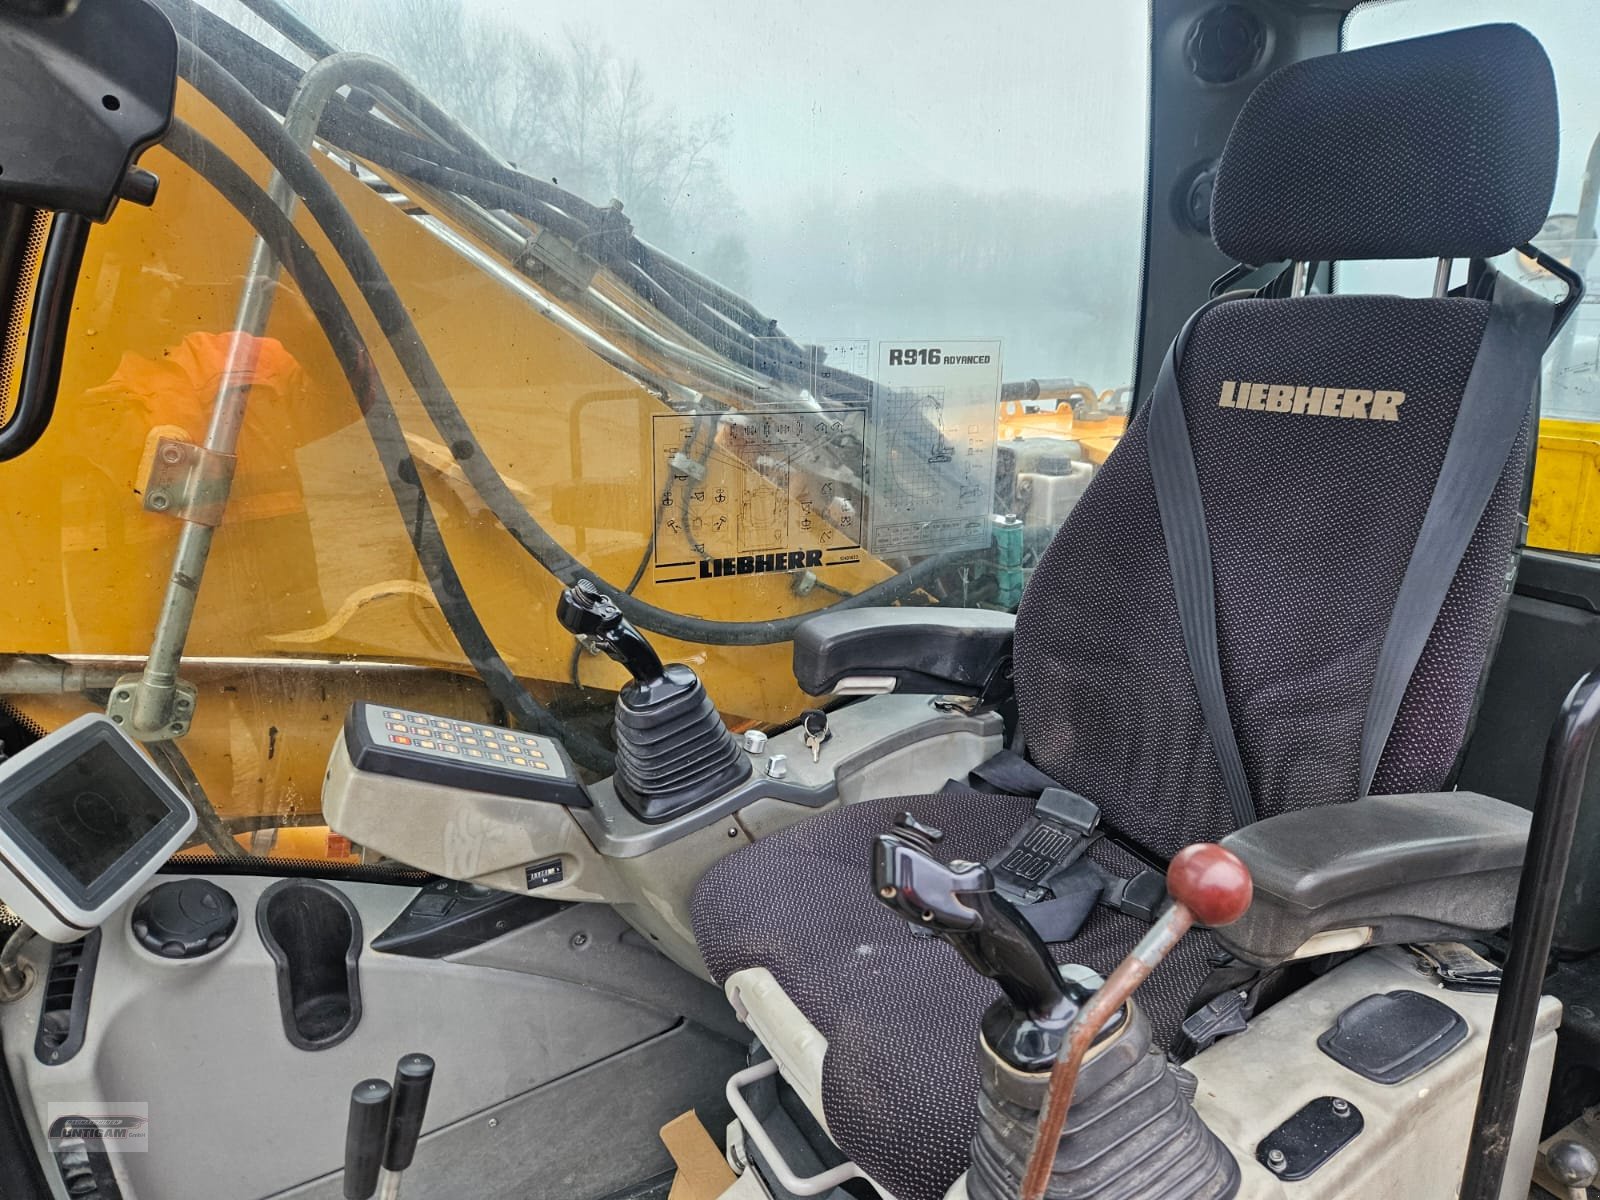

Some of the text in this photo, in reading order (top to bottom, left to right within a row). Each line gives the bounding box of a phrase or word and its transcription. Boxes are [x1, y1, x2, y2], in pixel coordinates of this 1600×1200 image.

[889, 348, 991, 366] R916 ADVANCED
[1218, 381, 1406, 421] LIEBHERR
[699, 549, 824, 579] LIEBHERR
